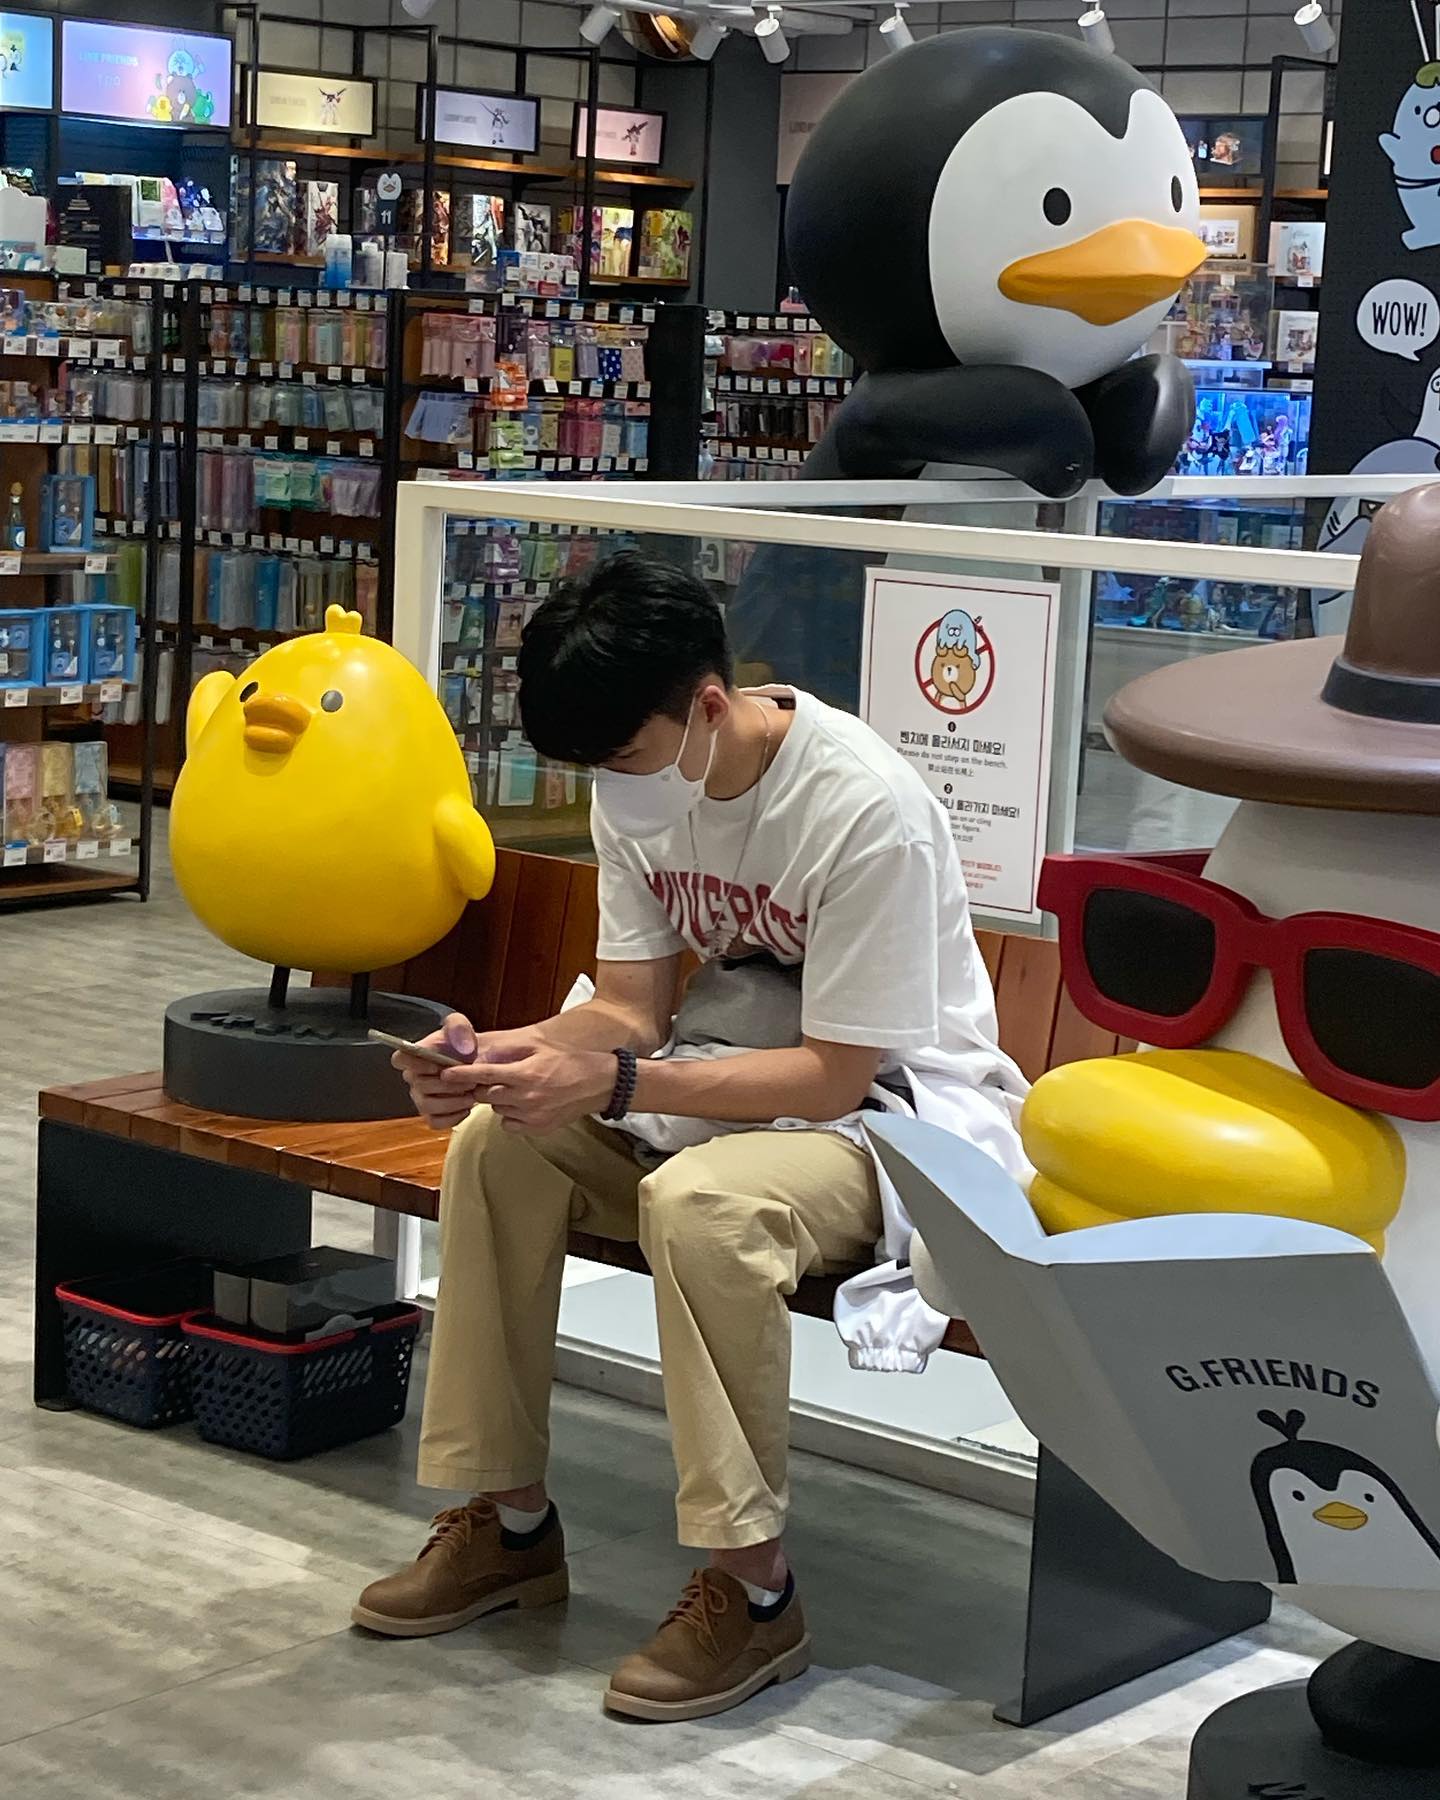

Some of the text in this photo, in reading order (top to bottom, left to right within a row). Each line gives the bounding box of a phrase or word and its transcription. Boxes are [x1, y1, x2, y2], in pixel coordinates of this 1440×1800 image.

[381, 210, 392, 224] 11
[1372, 301, 1428, 337] WOW!
[1165, 1358, 1380, 1409] G.FRIENDS
